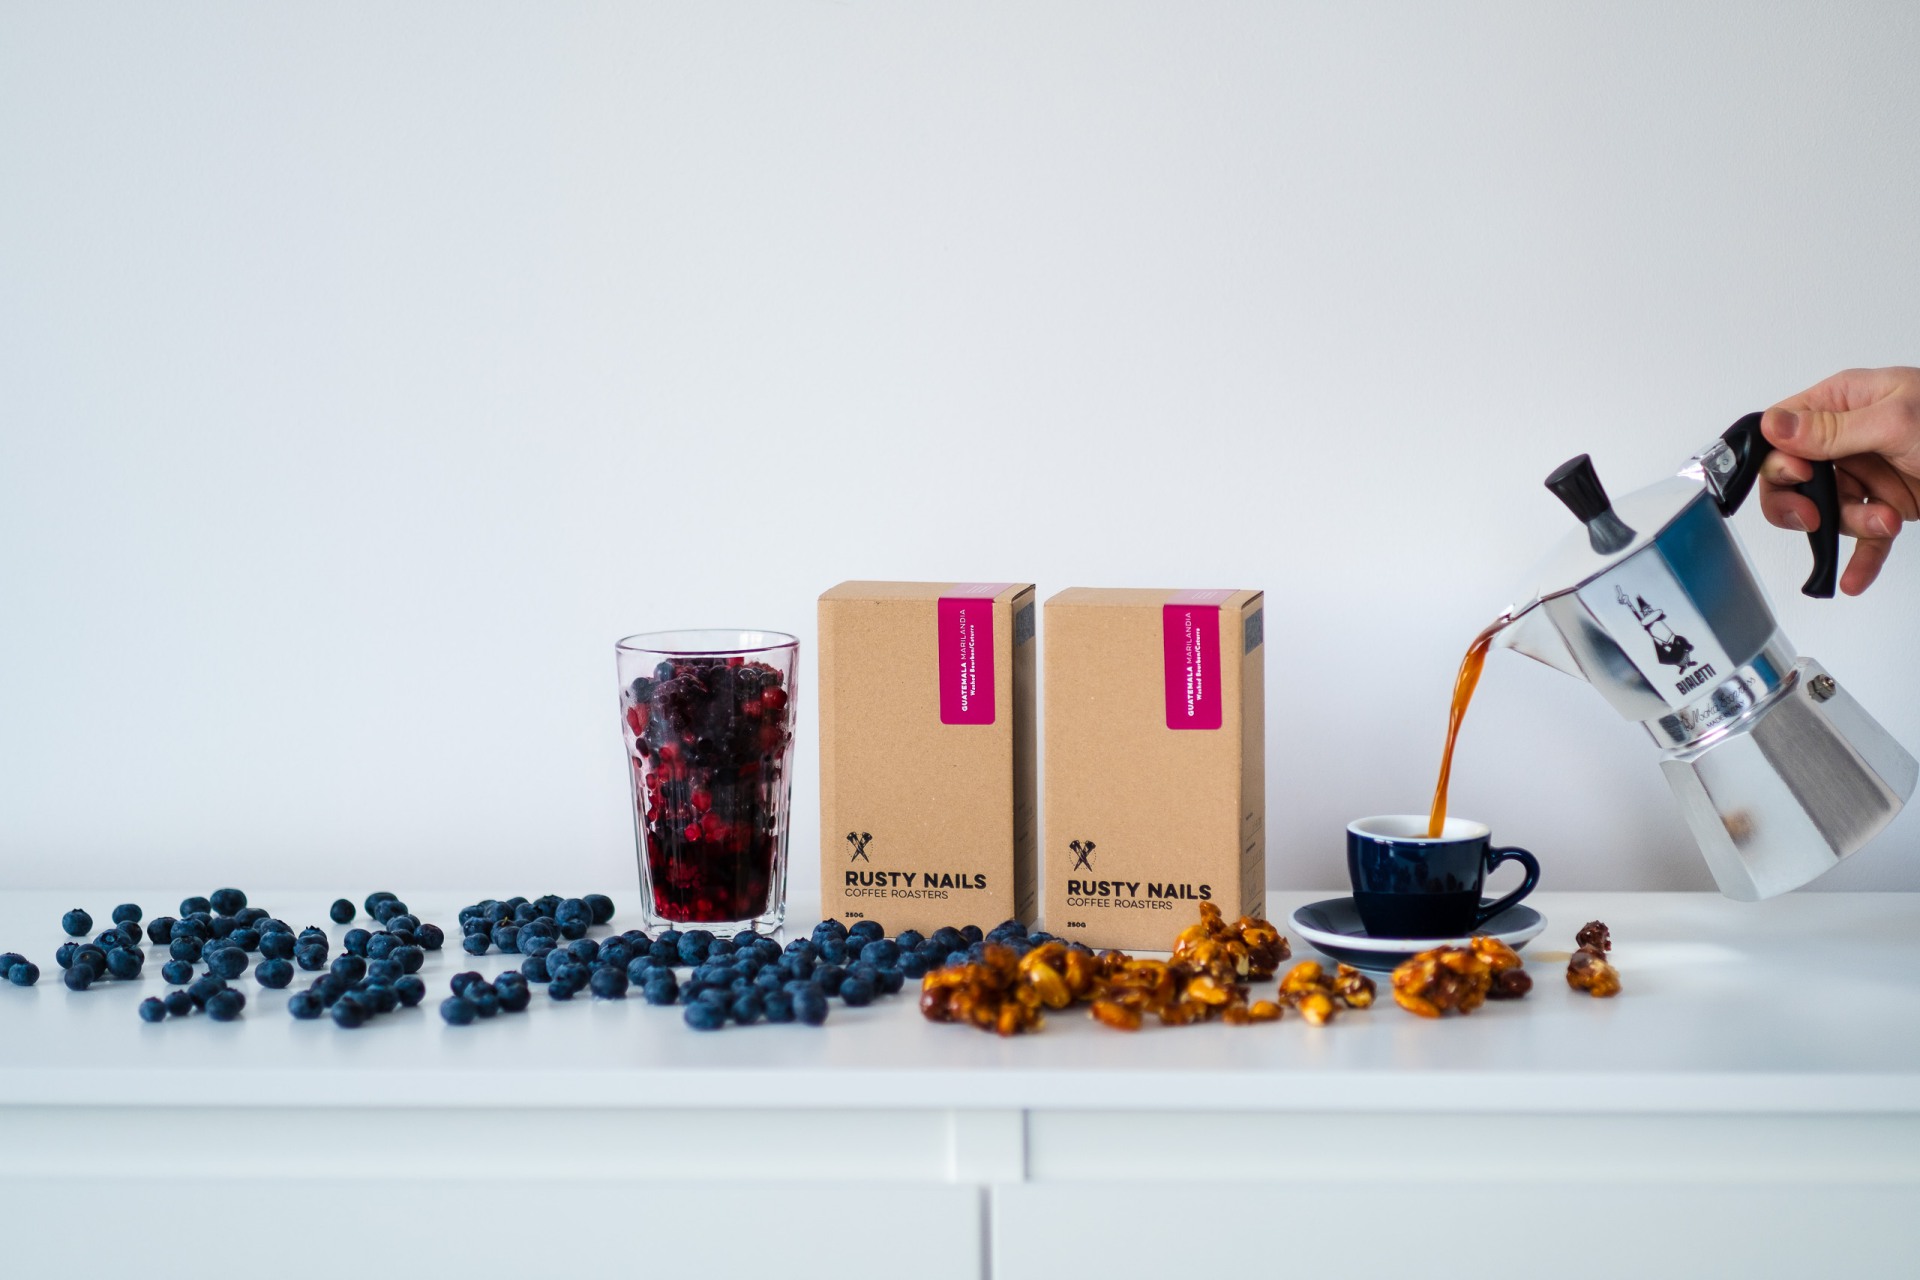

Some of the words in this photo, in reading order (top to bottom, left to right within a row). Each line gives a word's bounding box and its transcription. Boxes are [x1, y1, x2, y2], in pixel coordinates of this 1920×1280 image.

[1675, 663, 1717, 696] BIALETTI
[1186, 666, 1194, 717] GUATEMALA
[845, 871, 916, 888] RUSTY
[923, 873, 987, 890] NAILS
[1067, 880, 1140, 897] RUSTY
[1147, 883, 1212, 900] NAILS
[845, 888, 888, 898] COFFEE
[891, 889, 949, 900] ROASTERS
[1067, 897, 1111, 908] COFFEE
[1114, 899, 1173, 910] ROASTERS
